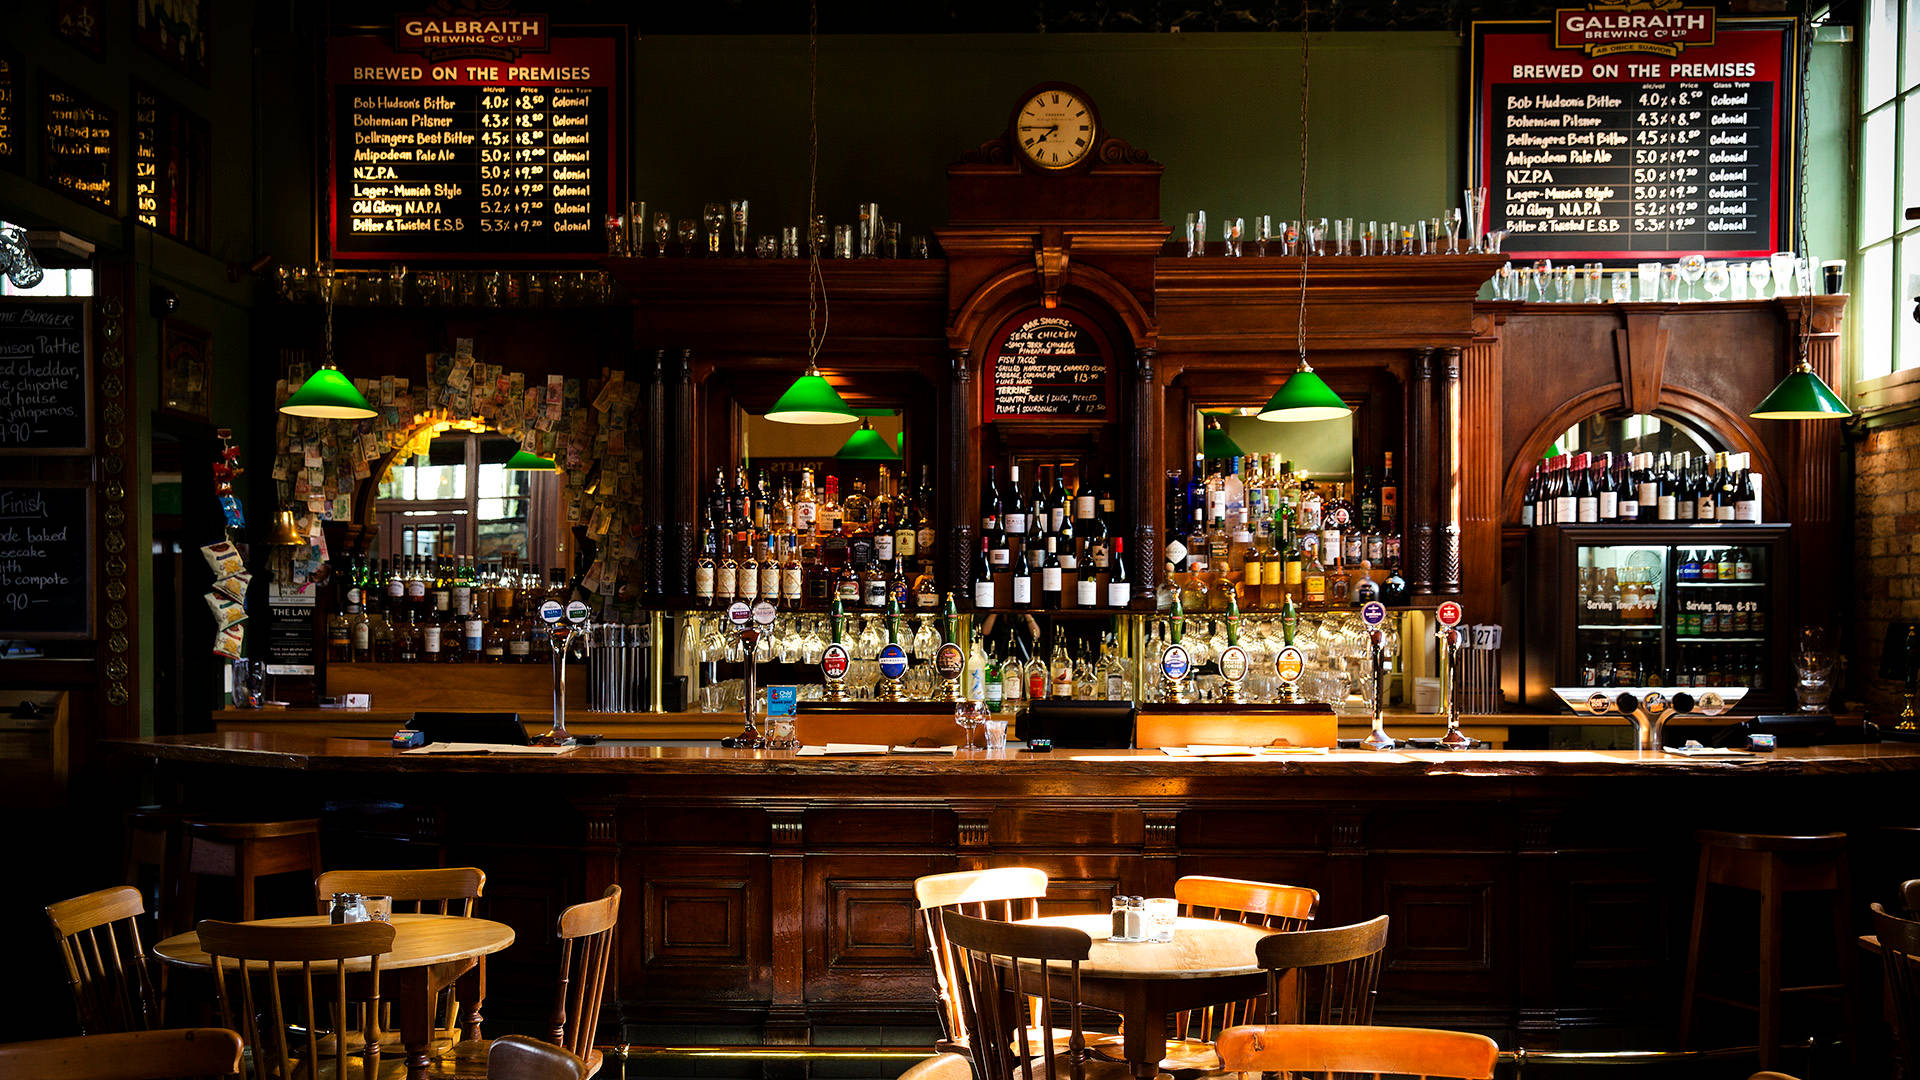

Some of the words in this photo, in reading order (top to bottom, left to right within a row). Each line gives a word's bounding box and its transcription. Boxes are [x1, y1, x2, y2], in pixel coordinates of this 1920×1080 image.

[406, 21, 538, 36] GALBRAITH
[1566, 15, 1704, 32] GALBRAITH
[354, 67, 422, 80] BREWED
[432, 67, 457, 80] ON
[467, 67, 498, 80] THE
[509, 67, 590, 80] PREMISES
[1513, 65, 1583, 78] BREWED
[1592, 65, 1618, 78] ON
[1628, 64, 1660, 78] THE
[1670, 63, 1755, 77] PREMISES
[354, 97, 375, 109] Bob
[378, 96, 420, 109] Hudson's
[424, 96, 456, 110] Bitter
[553, 96, 589, 108] Colonial
[1508, 96, 1532, 110] Bob
[1587, 95, 1622, 109] Bitter
[1711, 92, 1748, 106] Colonial
[354, 114, 408, 126] Bohemian
[412, 114, 453, 127] Pilsner
[553, 114, 588, 127] Colonial
[1507, 115, 1560, 128] Bohemian
[1563, 114, 1602, 127] Pilsner
[1711, 112, 1747, 125] Colonial
[355, 131, 414, 147] Bellringers
[417, 131, 442, 145] Best
[444, 131, 475, 144] Bitter
[553, 131, 589, 144] Colonial
[1507, 133, 1566, 149] Bellringers
[1568, 132, 1594, 146] Best
[1597, 132, 1628, 146] Bitter
[1710, 131, 1747, 145] Colonial
[354, 148, 412, 164] Antipodean
[416, 149, 436, 161] Pale
[438, 149, 455, 161] Ale
[553, 149, 590, 162] Colonial
[1506, 151, 1567, 168] Antipodean
[1570, 150, 1593, 163] Pale
[1594, 149, 1612, 163] Ale
[1709, 150, 1747, 163] Colonial
[553, 166, 590, 180] Colonial
[1709, 168, 1747, 182] Colonial
[434, 184, 462, 199] Style
[553, 184, 590, 197] Colonial
[1585, 187, 1614, 201] Style
[1709, 186, 1746, 198] Colonial
[352, 201, 372, 213] Old
[373, 200, 402, 216] Glory
[554, 202, 590, 214] Colonial
[1506, 204, 1524, 216] Old
[1527, 203, 1554, 218] Glory
[1708, 201, 1746, 215] Colonial
[353, 218, 384, 232] Bitter
[386, 220, 394, 231] &
[394, 219, 430, 231] Twisted
[554, 219, 590, 232] Colonial
[1506, 220, 1536, 232] Bitter
[1538, 221, 1548, 231] &
[1548, 219, 1584, 231] Twisted
[1708, 218, 1746, 231] Colonial
[36, 335, 80, 354] Pattie
[998, 356, 1015, 364] FISH
[1017, 356, 1037, 364] TACOS
[27, 526, 67, 542] baked
[15, 572, 70, 589] compote
[1587, 600, 1612, 611] Serving
[1686, 600, 1712, 612] Serving
[1477, 630, 1491, 645] 27
